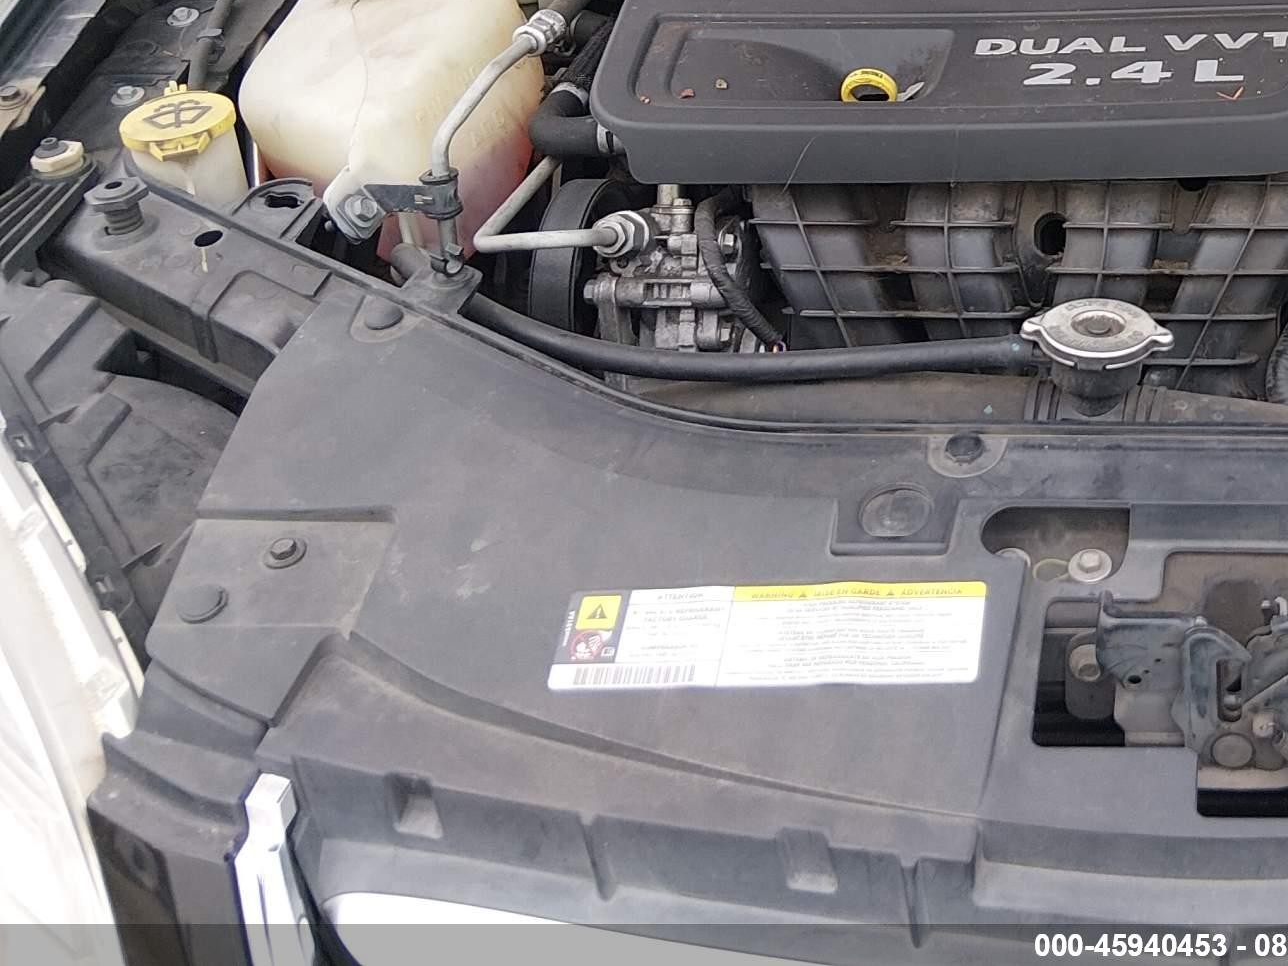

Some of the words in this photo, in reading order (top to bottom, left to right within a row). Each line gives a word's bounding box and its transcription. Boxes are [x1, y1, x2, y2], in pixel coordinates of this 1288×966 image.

[974, 36, 1147, 55] DUAL
[1023, 61, 1173, 85] 2.4
[1194, 59, 1244, 83] L
